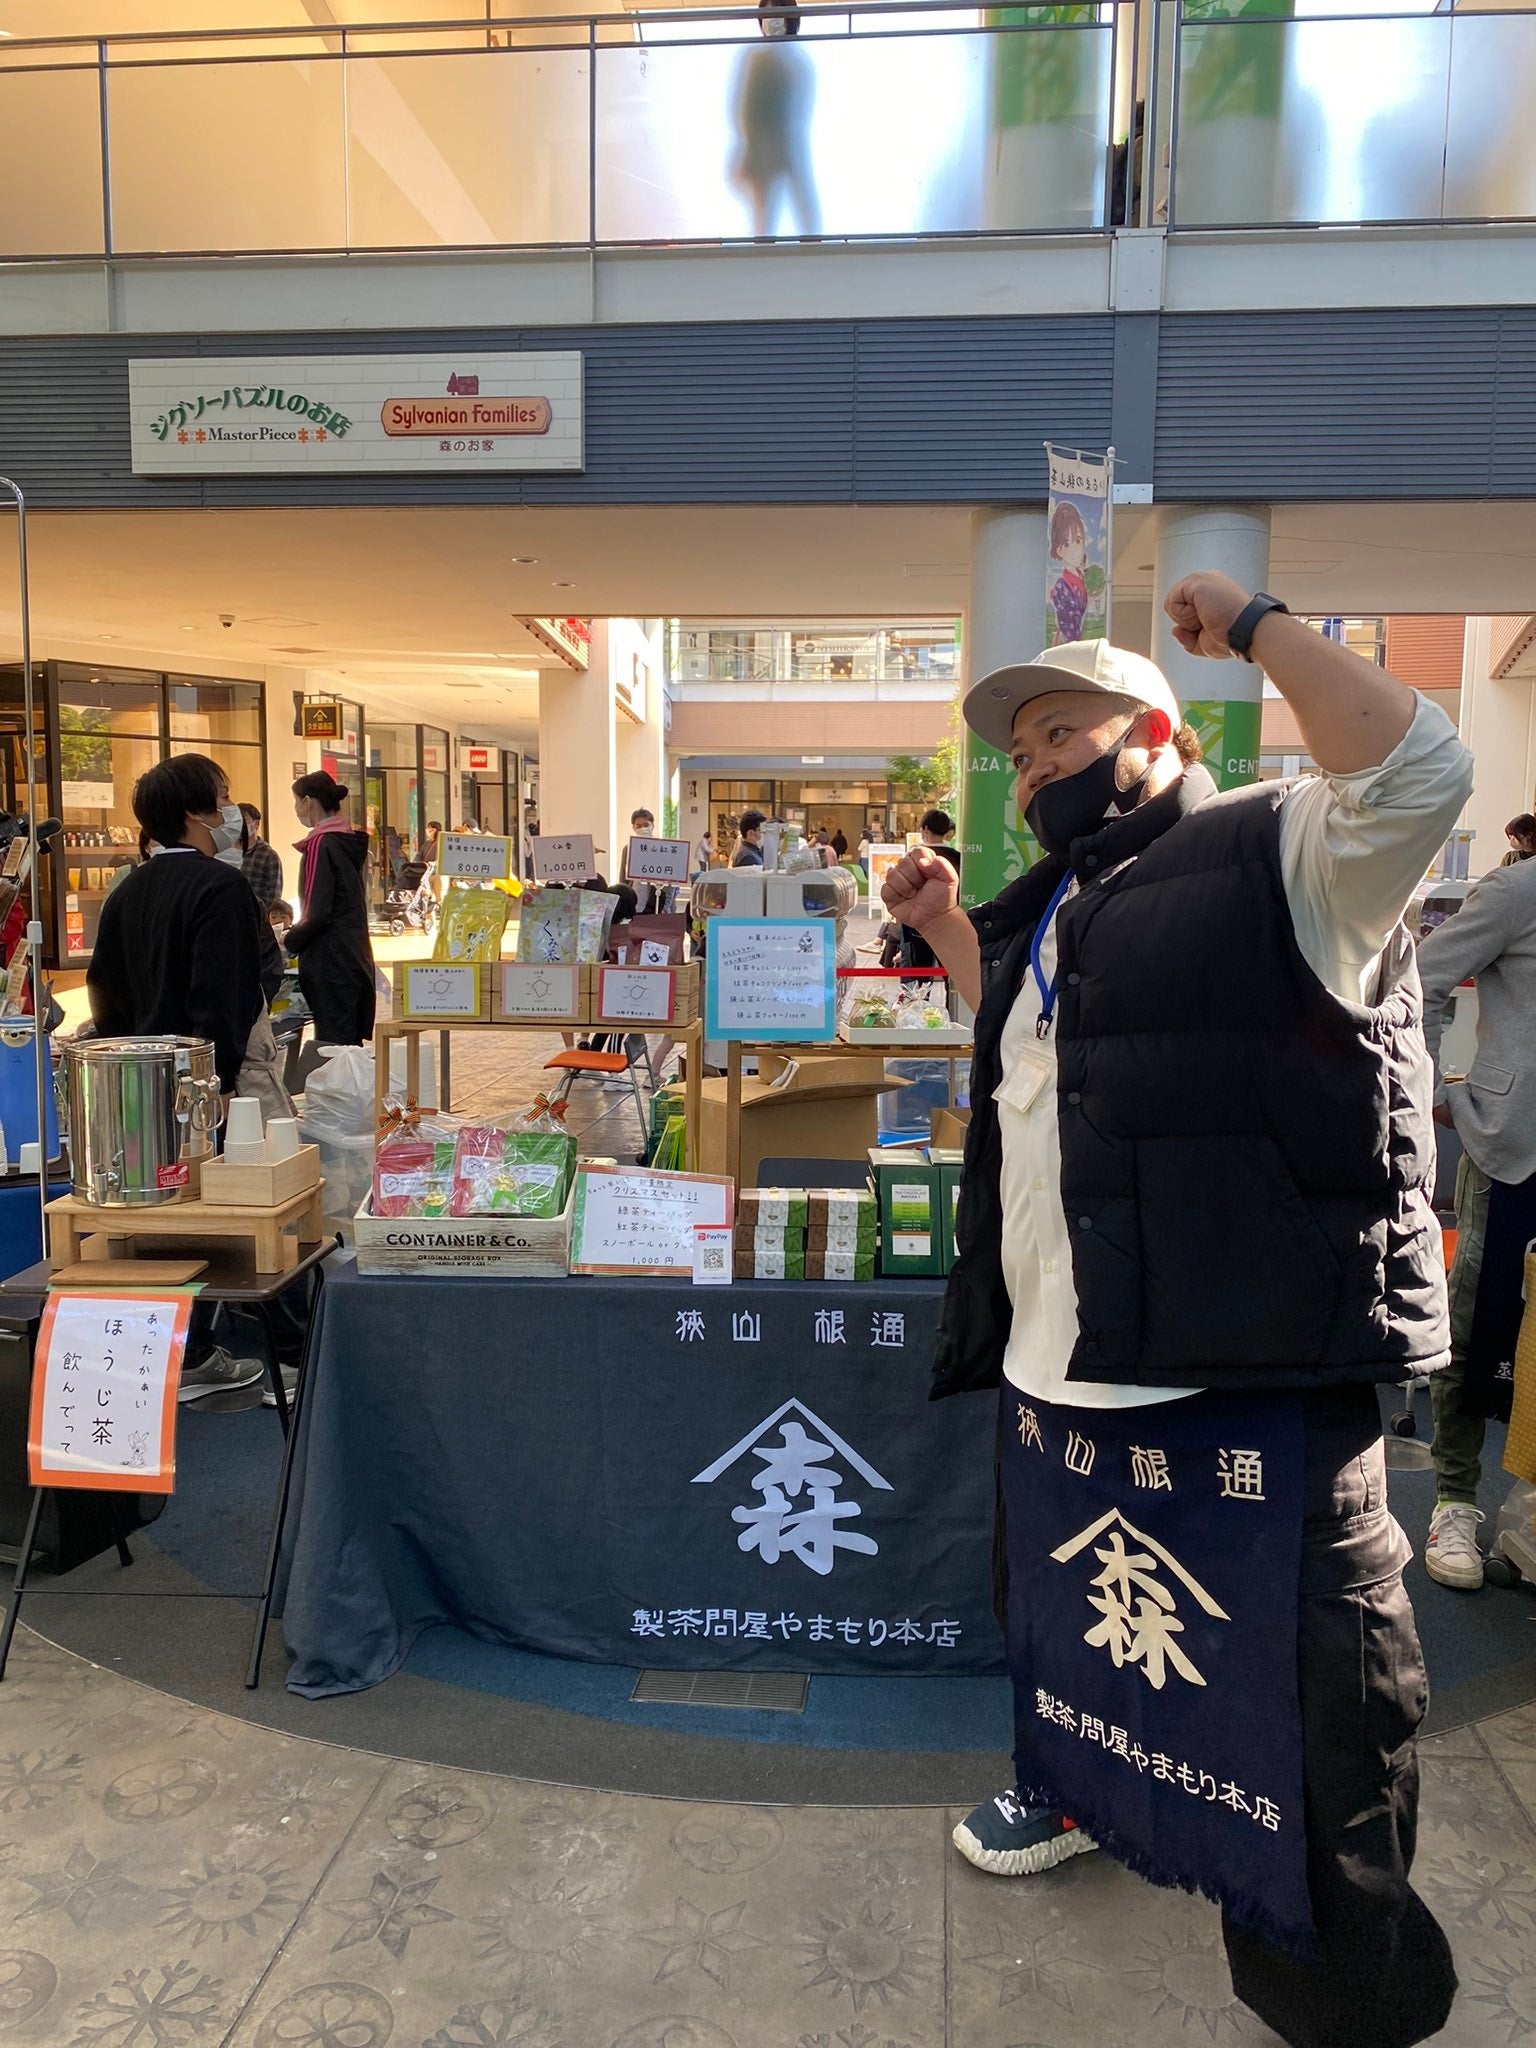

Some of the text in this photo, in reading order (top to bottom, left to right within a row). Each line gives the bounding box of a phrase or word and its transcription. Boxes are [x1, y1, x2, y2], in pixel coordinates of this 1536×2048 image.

[150, 386, 354, 441] ジグソーパズルのお店
[392, 403, 537, 429] Sylvanian Families
[438, 440, 495, 453] 森のお家
[471, 754, 486, 763] LEGO
[640, 843, 679, 855] 狭山紅茶
[457, 863, 491, 874] 800円
[641, 864, 674, 875] 600円
[617, 1206, 693, 1218] 緑茶ティーバッグ
[616, 1221, 693, 1235] 紅茶ティーバッグ
[386, 1233, 532, 1248] CONTAINER & Co.
[602, 1239, 654, 1248] スノーボール
[706, 1233, 728, 1241] PayPay
[91, 1318, 123, 1446] ほうじ茶
[60, 1351, 82, 1455] 飲んでって
[630, 1608, 962, 1647] 製茶問屋やまもり本店
[1034, 1687, 1282, 1832] 製茶問屋やまもり本店
